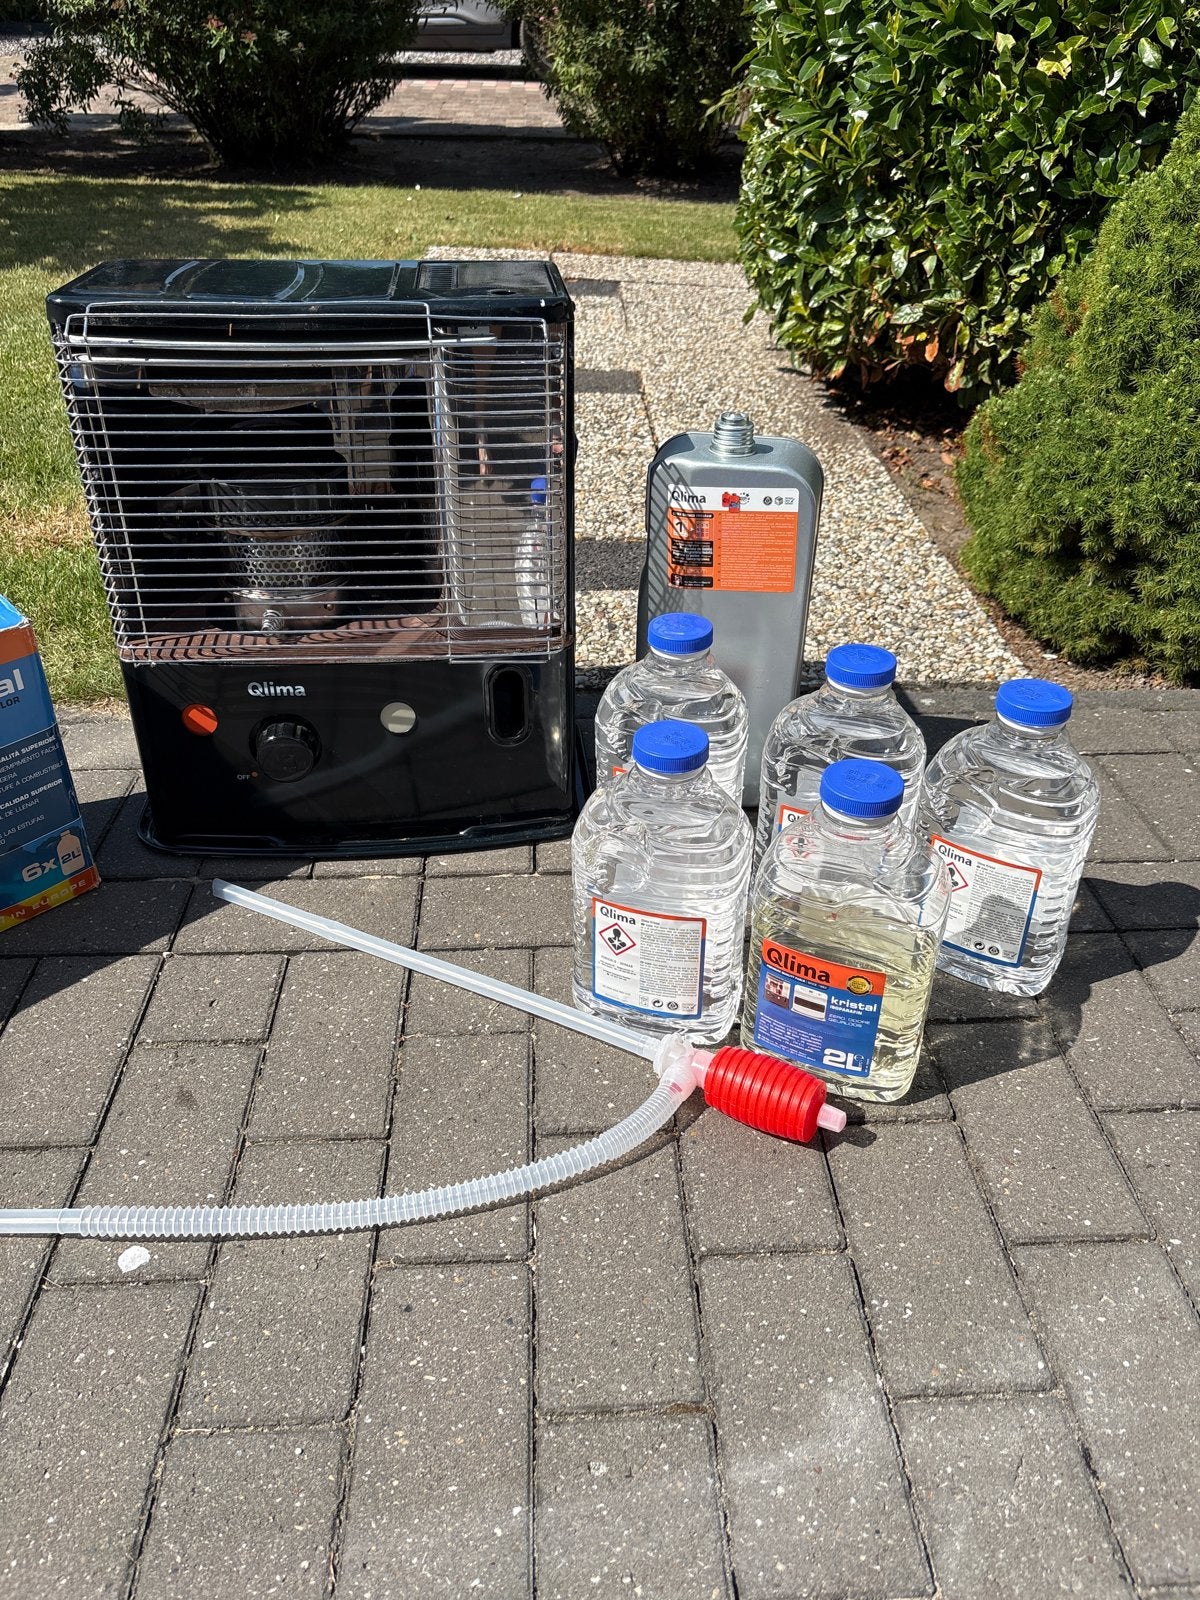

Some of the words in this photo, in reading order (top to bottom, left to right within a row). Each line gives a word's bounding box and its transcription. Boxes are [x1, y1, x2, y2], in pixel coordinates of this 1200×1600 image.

[671, 490, 706, 504] Qlima
[247, 681, 306, 697] Qlima
[31, 778, 63, 797] SUPERIOR
[17, 814, 45, 831] ESTUFAS
[938, 844, 972, 867] Qlima
[32, 879, 87, 910] EUROPE
[600, 906, 636, 926] Qlima
[766, 948, 831, 983] Qlima
[831, 996, 877, 1012] kristal
[822, 1048, 863, 1072] 2L
